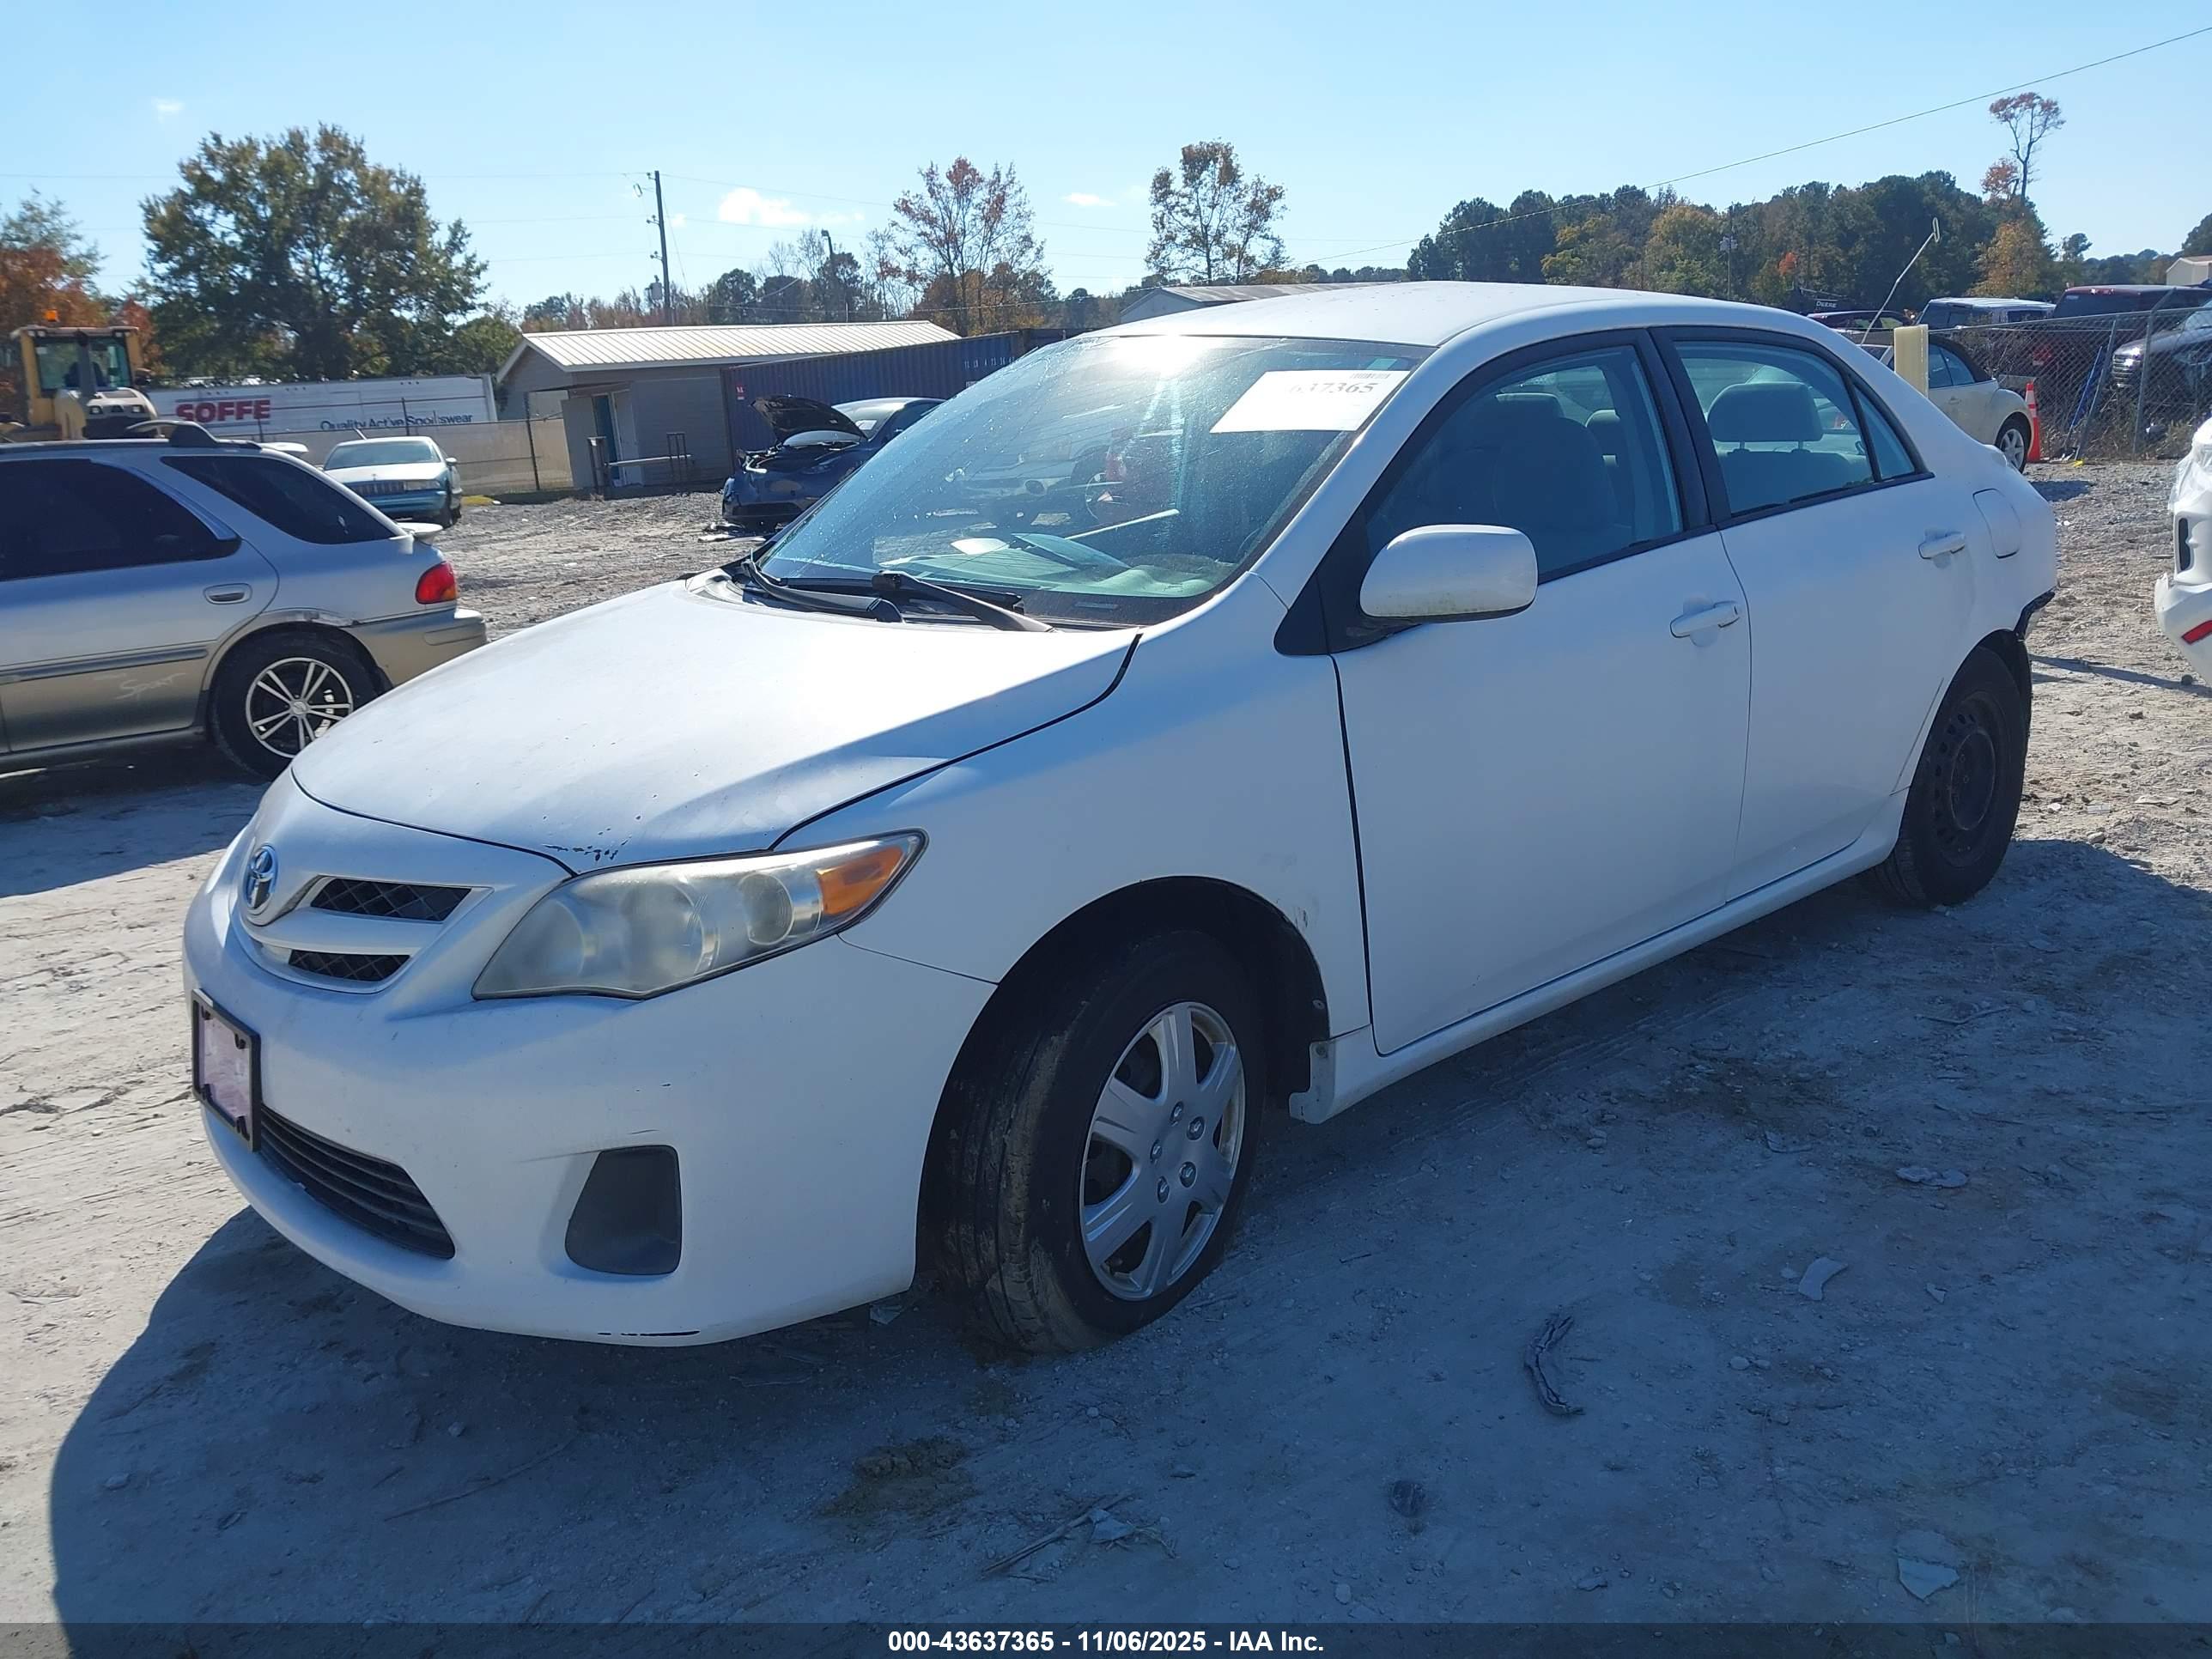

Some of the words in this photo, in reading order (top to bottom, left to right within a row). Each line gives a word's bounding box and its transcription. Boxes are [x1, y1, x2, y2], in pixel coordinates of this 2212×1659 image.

[176, 399, 270, 422] SOFFE
[320, 419, 366, 430] Quality
[369, 416, 404, 428] Active
